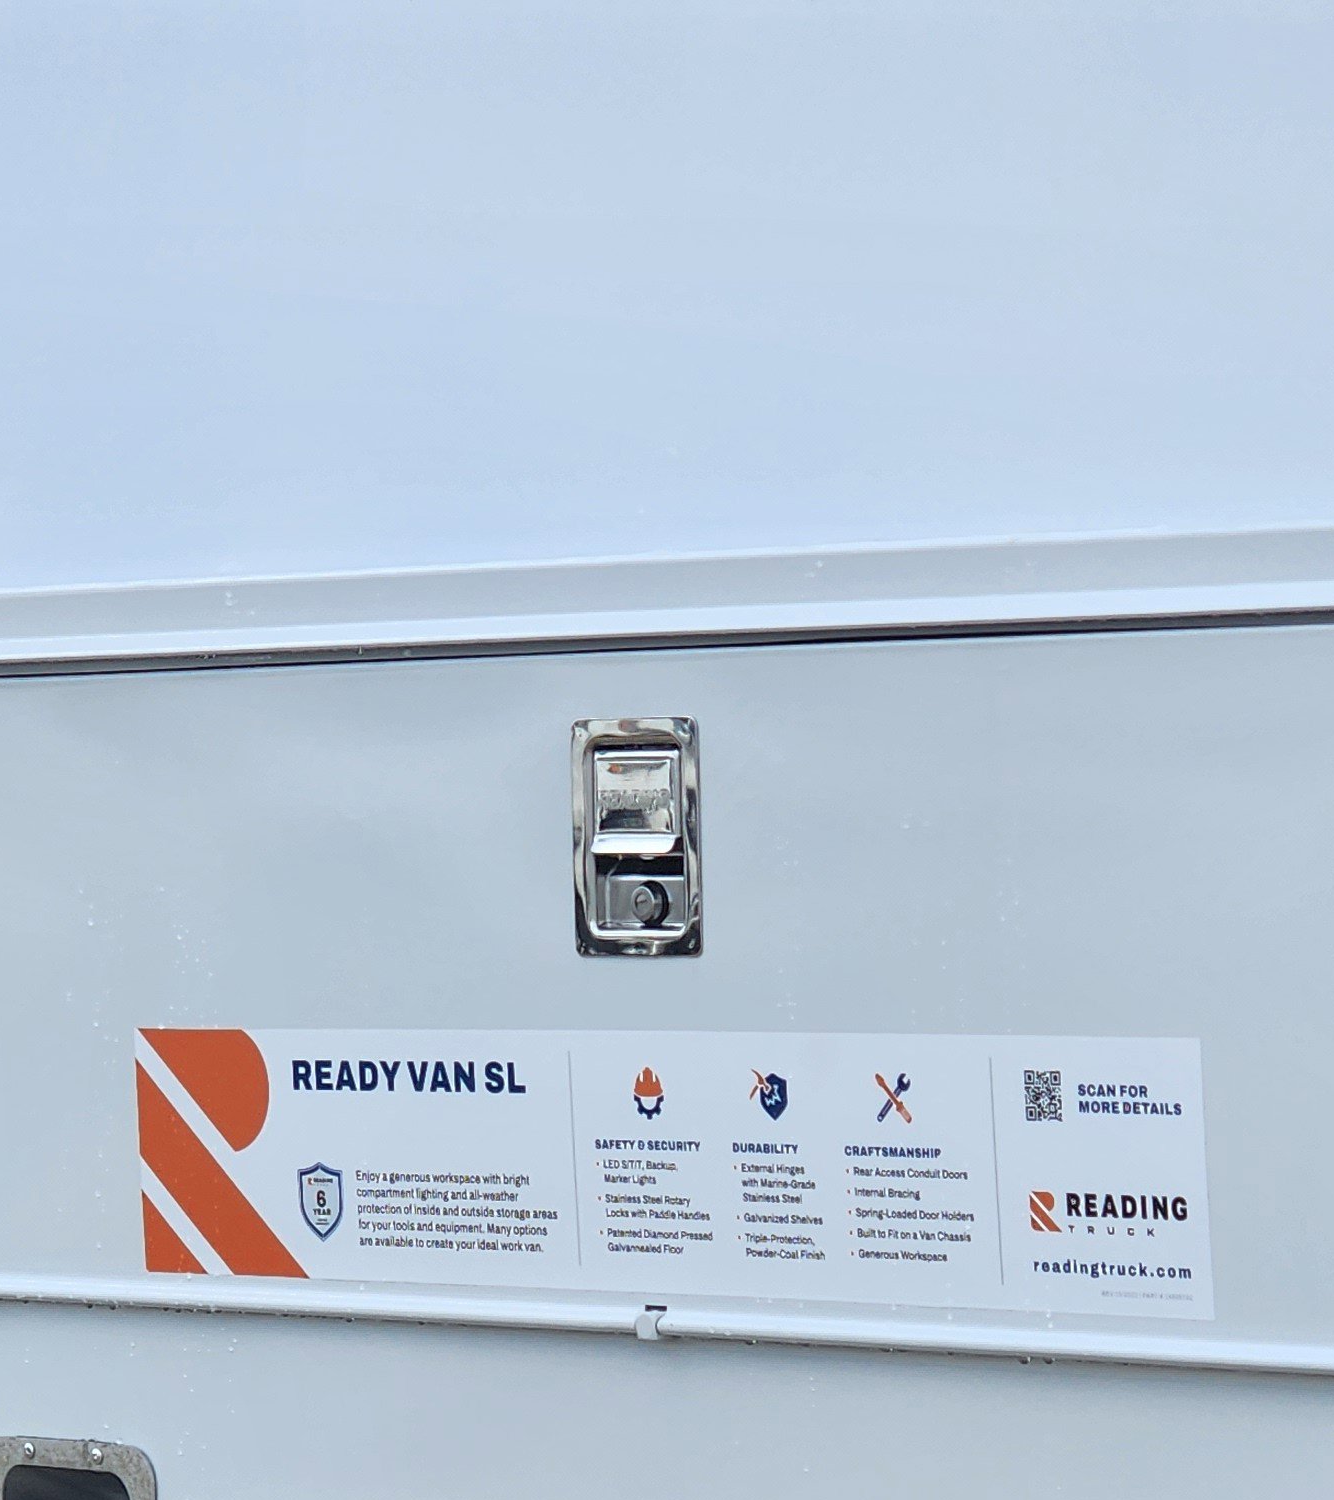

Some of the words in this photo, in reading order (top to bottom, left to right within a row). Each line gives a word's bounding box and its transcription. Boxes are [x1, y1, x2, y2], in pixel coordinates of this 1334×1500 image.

[291, 1059, 401, 1092] READY
[408, 1060, 476, 1094] VAN
[485, 1062, 526, 1095] SL
[1077, 1083, 1116, 1097] SCAN
[1120, 1085, 1148, 1098] FOR
[1078, 1101, 1120, 1114] MORE
[1122, 1102, 1182, 1116] DETAILS
[595, 1139, 636, 1150] SAFETY
[647, 1140, 701, 1152] SECURITY
[732, 1143, 798, 1154] DURABILITY
[844, 1146, 941, 1158] CRAFTSMANSHIP
[603, 1160, 620, 1169] LED
[741, 1163, 775, 1174] External
[776, 1164, 805, 1176] Hinges
[356, 1170, 381, 1183] Enjoy
[389, 1172, 431, 1184] generous
[432, 1172, 481, 1185] workspace
[482, 1173, 501, 1184] with
[503, 1173, 530, 1188] bright
[604, 1174, 631, 1183] Marker
[632, 1174, 657, 1186] Lights
[853, 1166, 873, 1177] Rear
[875, 1168, 905, 1178] Access
[907, 1168, 941, 1179] Conduit
[942, 1169, 968, 1180] Doors
[742, 1178, 759, 1187] with
[760, 1179, 816, 1189] Marine-Grade
[316, 1190, 326, 1207] 6
[357, 1188, 414, 1199] compartment
[416, 1187, 449, 1202] lighting
[451, 1189, 467, 1200] and
[469, 1189, 519, 1202] all-weather
[605, 1193, 641, 1204] Stainless
[643, 1195, 663, 1204] Steel
[664, 1195, 691, 1208] Rotary
[742, 1192, 780, 1203] Stainless
[782, 1194, 803, 1204] Steel
[854, 1187, 886, 1198] Internal
[887, 1188, 921, 1201] Bracing
[313, 1208, 331, 1216] YEAR
[357, 1204, 402, 1215] protection
[403, 1204, 412, 1215] of
[414, 1205, 441, 1216] inside
[442, 1205, 459, 1216] and
[461, 1206, 494, 1218] outside
[496, 1208, 531, 1221] storage
[532, 1210, 558, 1220] areas
[1065, 1192, 1188, 1222] READING
[606, 1208, 629, 1218] Locks
[631, 1209, 647, 1219] with
[649, 1209, 676, 1219] Paddle
[677, 1210, 710, 1221] Handles
[744, 1212, 789, 1224] Galvanized
[791, 1214, 823, 1225] Shelves
[855, 1207, 917, 1220] Spring-Loaded
[919, 1210, 940, 1220] Door
[941, 1211, 975, 1222] Holders
[358, 1219, 370, 1230] for
[371, 1221, 391, 1233] your
[393, 1220, 415, 1231] tools
[417, 1221, 433, 1232] and
[487, 1223, 512, 1237] Many
[513, 1224, 548, 1237] options
[607, 1228, 642, 1238] Patented
[643, 1229, 679, 1240] Diamond
[681, 1231, 713, 1241] Pressed
[857, 1228, 876, 1238] Built
[878, 1229, 886, 1239] to
[887, 1229, 899, 1239] Fit
[900, 1231, 911, 1240] on
[919, 1230, 936, 1240] Van
[937, 1231, 971, 1242] Chassis
[359, 1237, 373, 1246] are
[375, 1236, 414, 1247] available
[415, 1237, 424, 1248] to
[426, 1239, 454, 1249] create
[455, 1240, 475, 1251] your
[477, 1239, 499, 1251] ideal
[500, 1240, 523, 1251] work
[663, 1244, 684, 1254] Floor
[800, 1250, 826, 1260] Finish
[858, 1248, 899, 1260] Generous
[901, 1250, 948, 1262] Workspace
[1033, 1259, 1192, 1279] readingtruck.com
